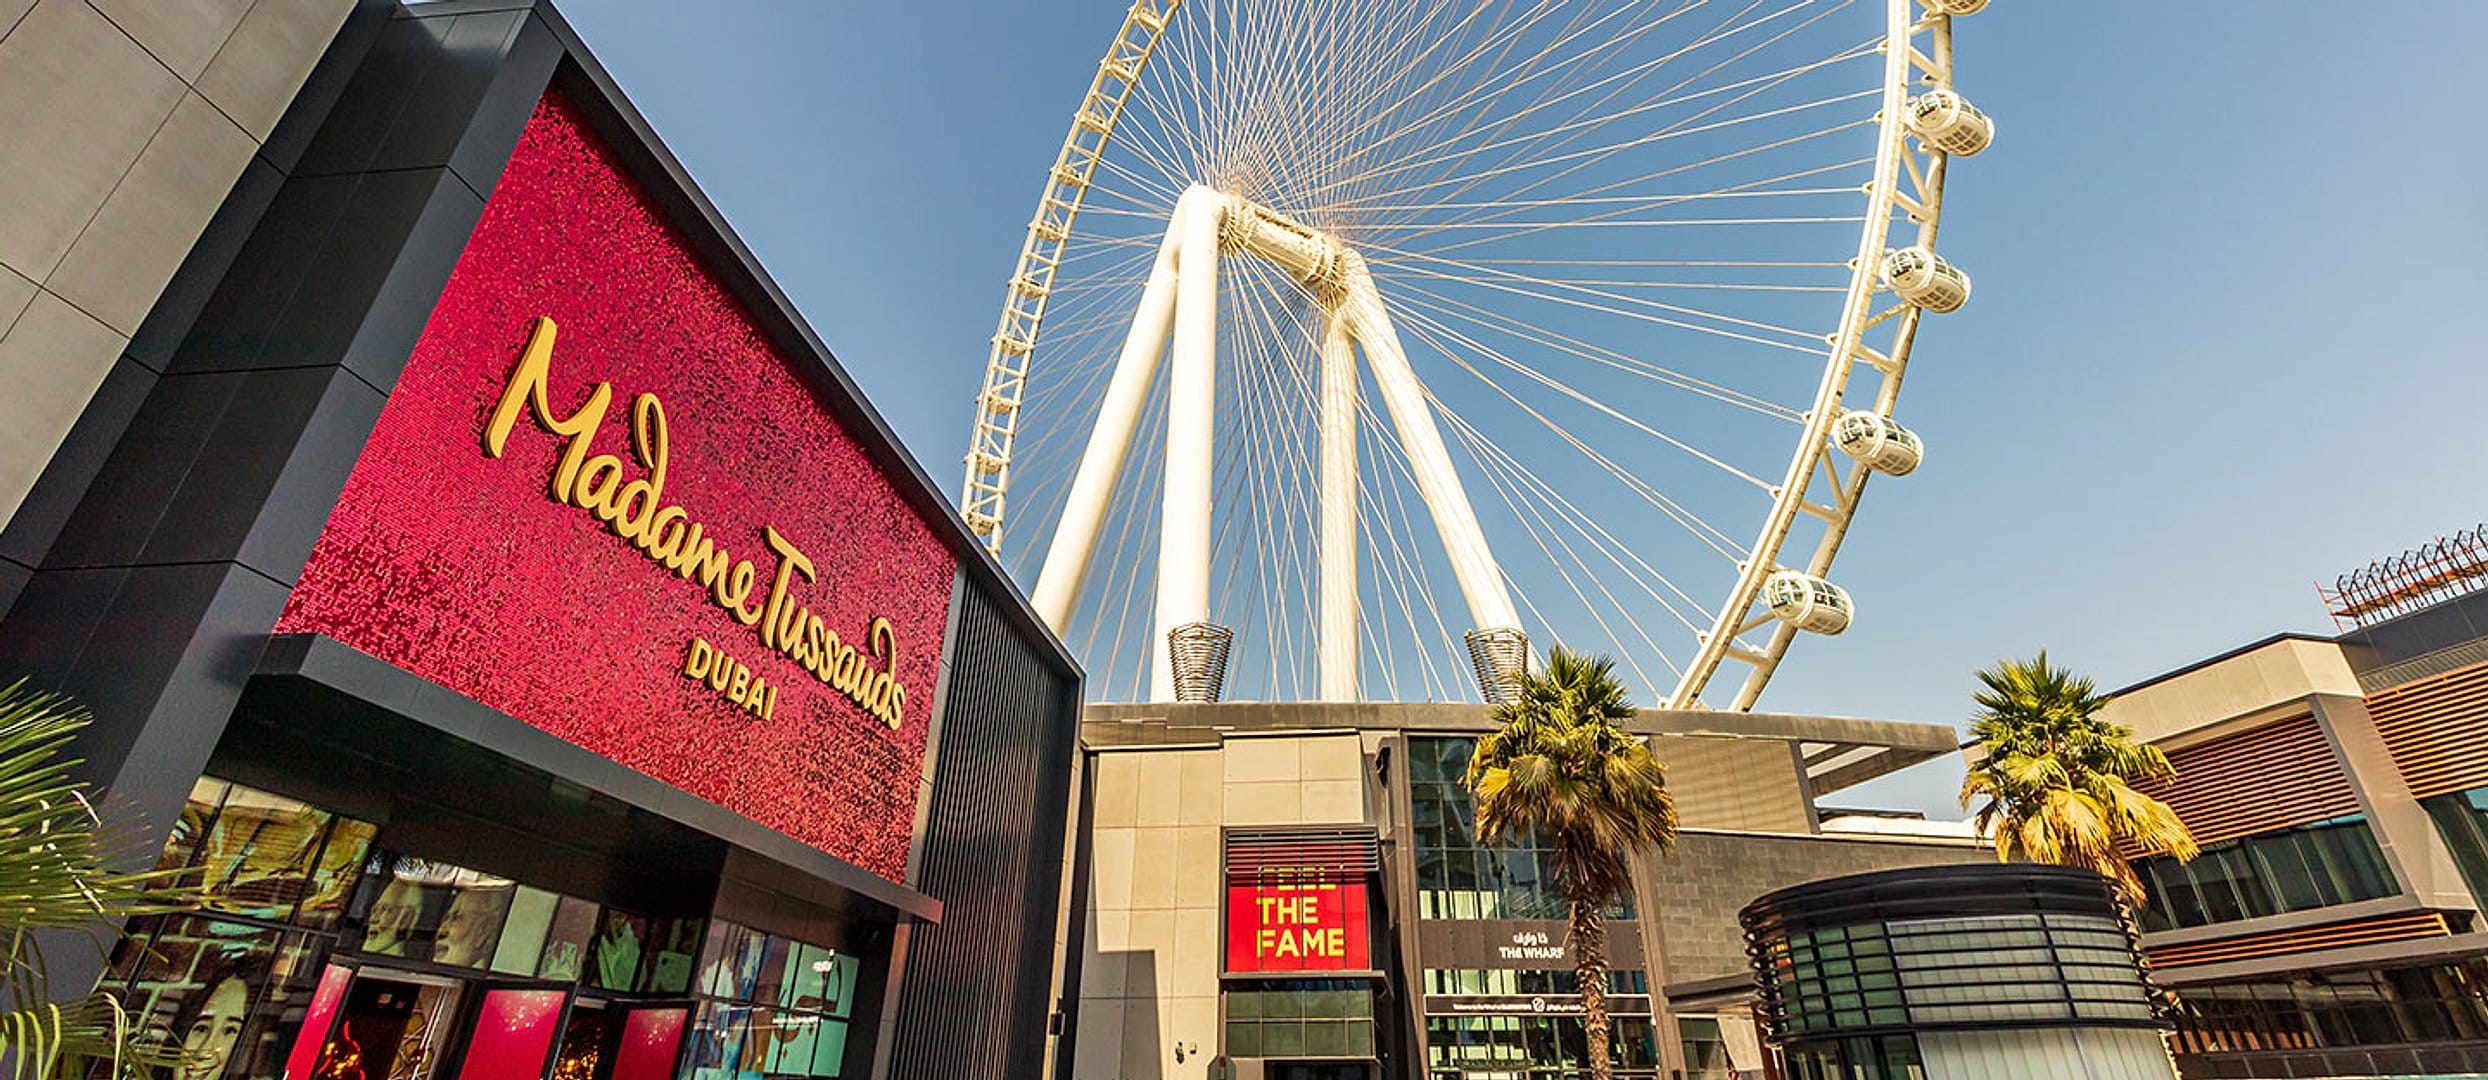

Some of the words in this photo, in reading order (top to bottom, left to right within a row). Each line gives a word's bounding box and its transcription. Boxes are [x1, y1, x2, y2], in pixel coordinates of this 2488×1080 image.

[484, 316, 763, 625] Madame
[761, 525, 907, 730] Tussauds
[685, 639, 778, 720] DUBAI
[1256, 896, 1318, 925] THE
[1256, 928, 1345, 957] FAME
[1499, 946, 1523, 959] THE
[1522, 946, 1565, 959] WHARF
